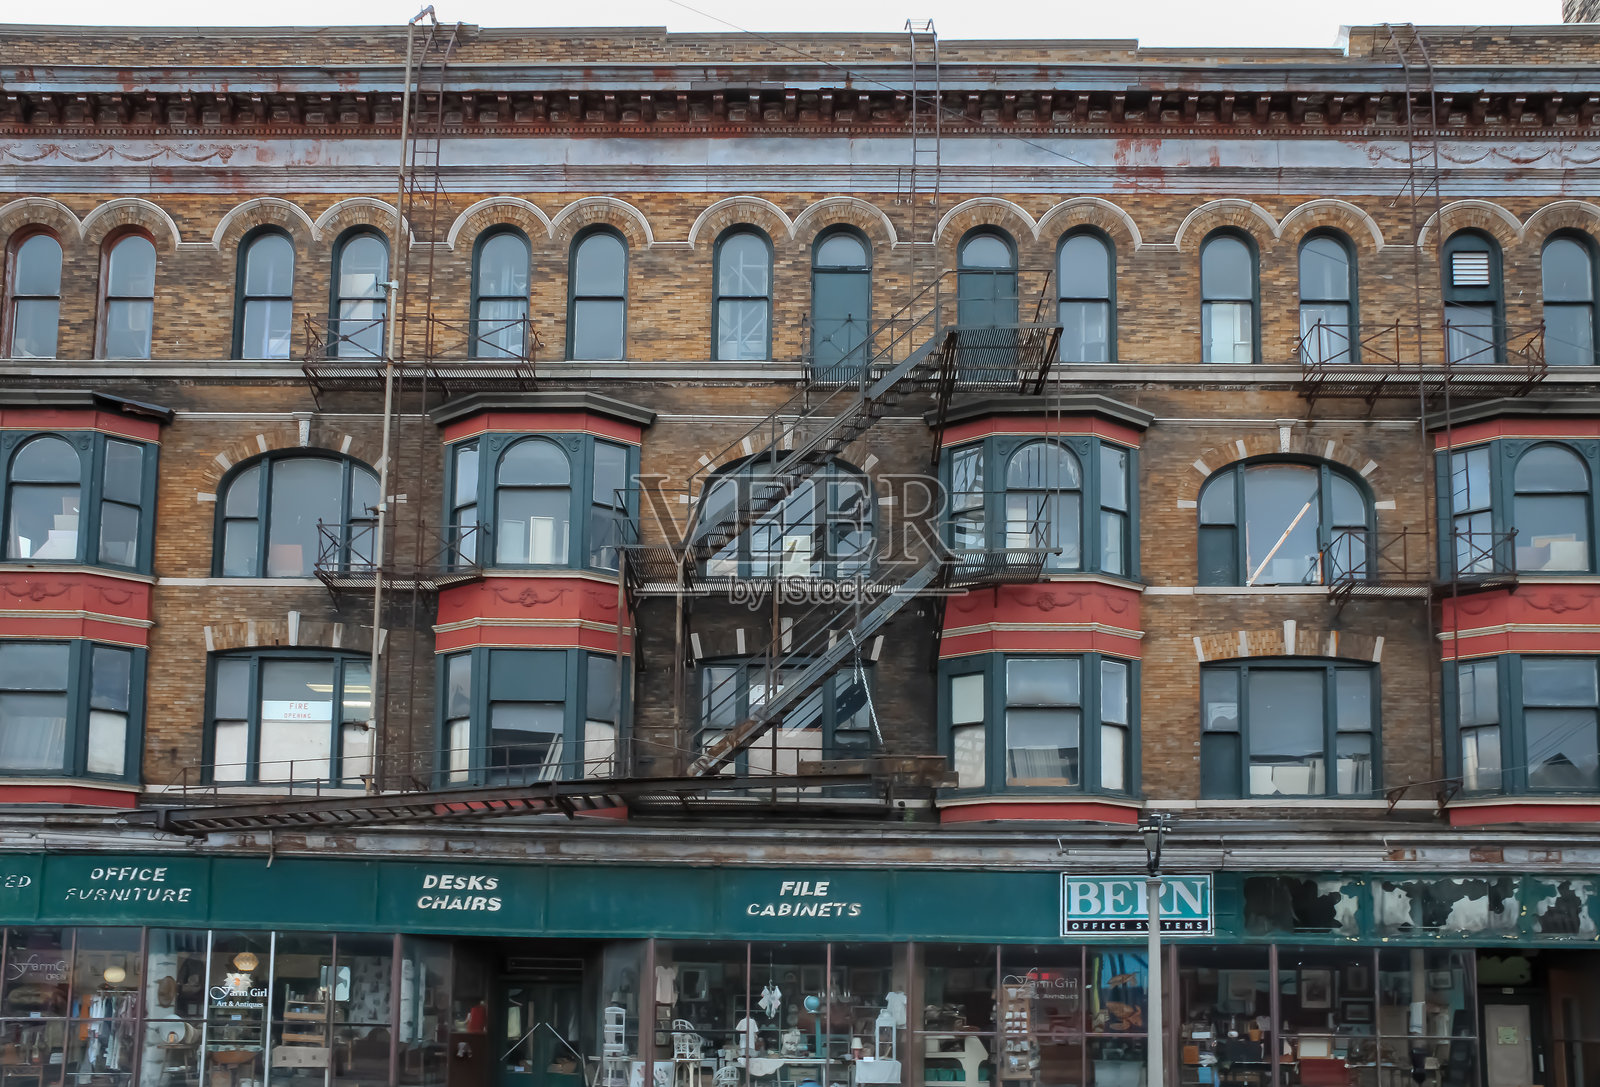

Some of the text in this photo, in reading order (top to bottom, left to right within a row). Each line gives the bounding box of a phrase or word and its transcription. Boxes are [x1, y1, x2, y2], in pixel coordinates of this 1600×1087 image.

[289, 702, 310, 710] FIRE
[0, 874, 32, 888] ED
[90, 867, 167, 882] OFFICE
[422, 874, 499, 891] DESKS
[780, 881, 830, 896] FILE
[65, 888, 192, 902] FURNITURE
[1068, 881, 1206, 915] BERN
[417, 895, 502, 912] CHAIRS
[746, 902, 862, 917] CABINETS
[1071, 921, 1203, 930] OFFICE STEMS
[1002, 967, 1078, 992] Farm Girl
[210, 985, 268, 1000] Farm Girl
[235, 1000, 264, 1009] Antiques
